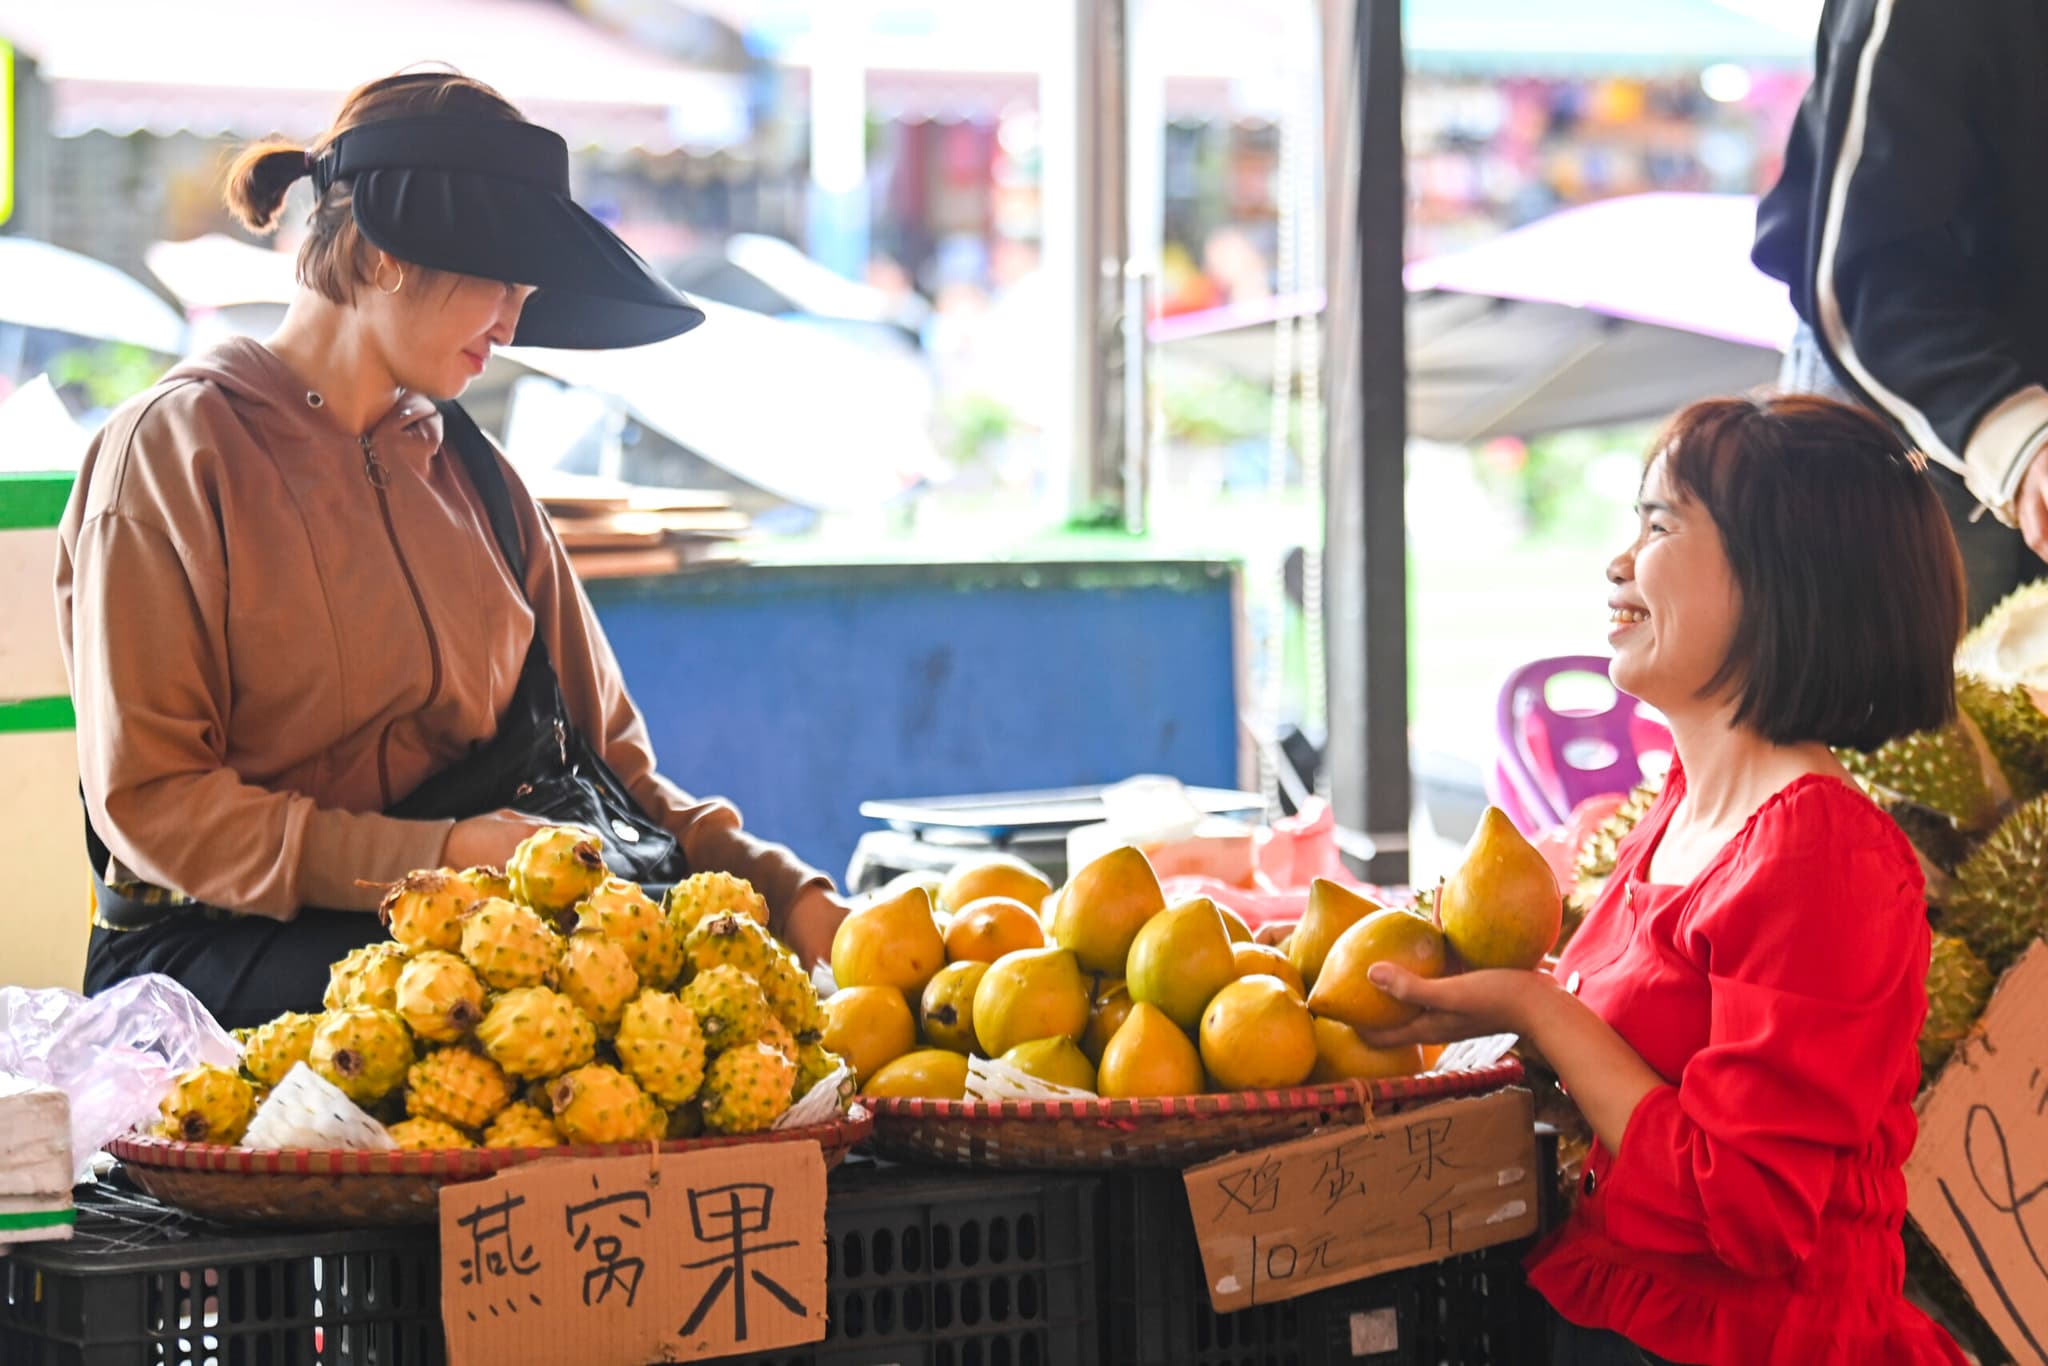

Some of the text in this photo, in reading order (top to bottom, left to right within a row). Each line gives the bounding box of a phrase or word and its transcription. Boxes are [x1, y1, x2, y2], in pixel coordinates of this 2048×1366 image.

[1211, 1117, 1463, 1223] 鸡蛋果
[457, 1173, 808, 1342] 燕窝果
